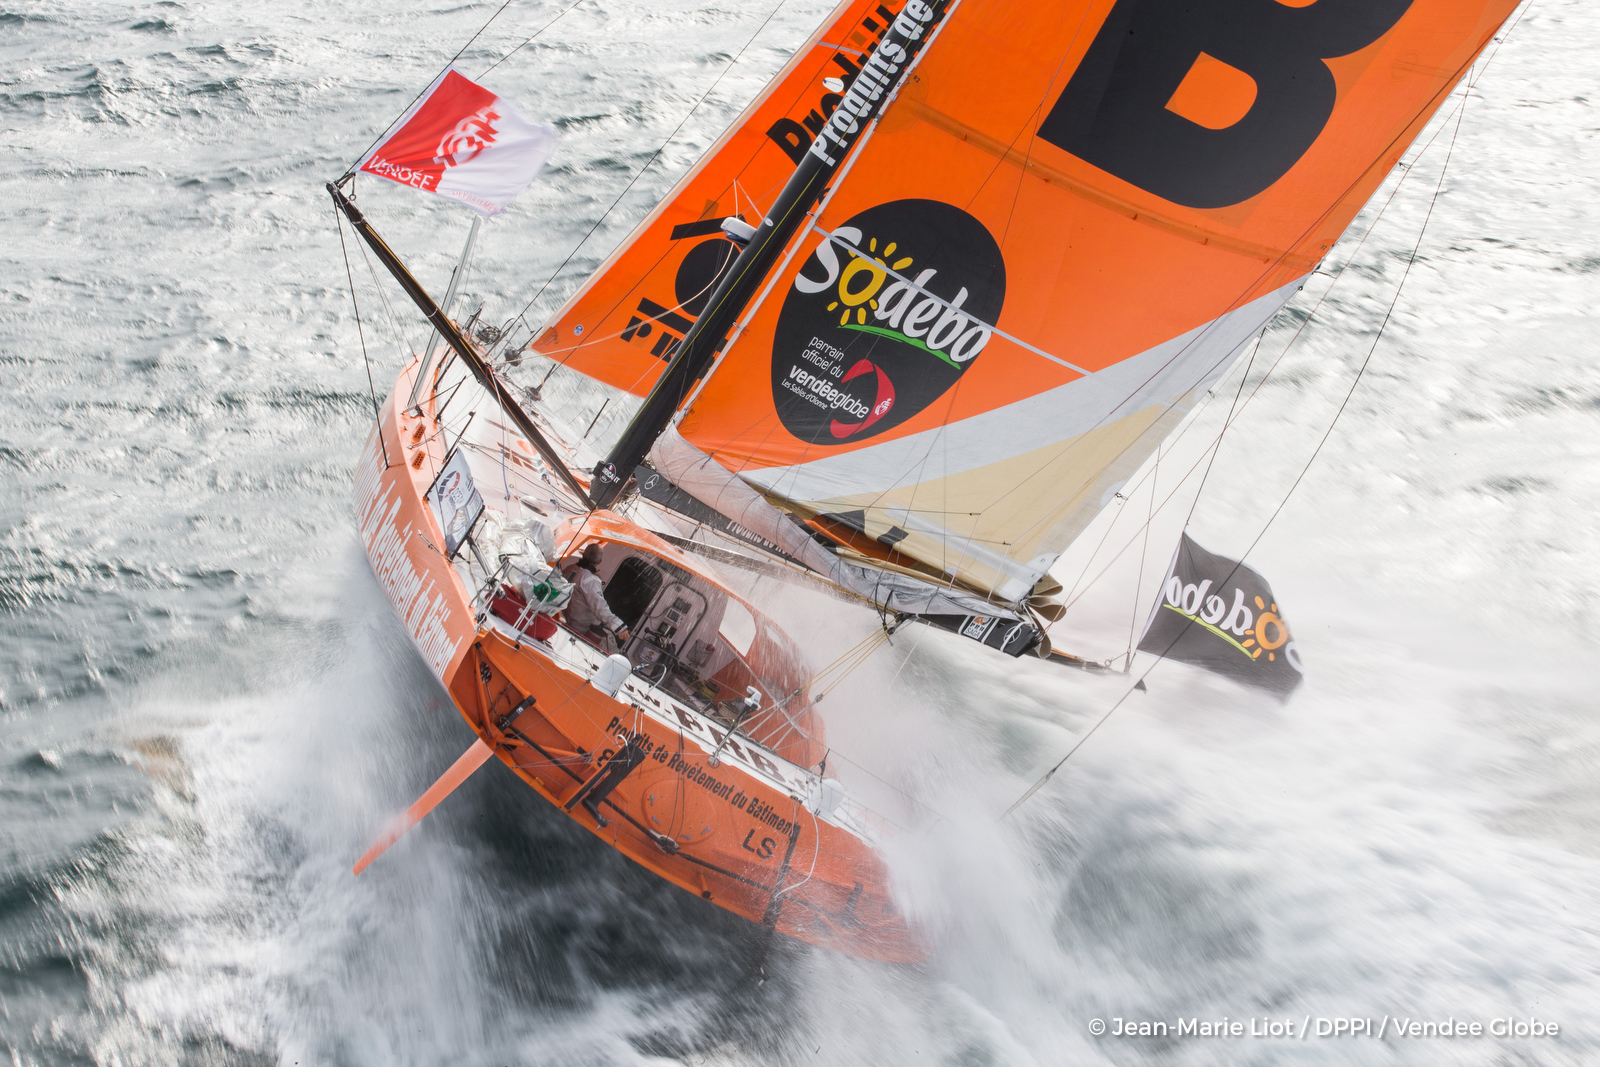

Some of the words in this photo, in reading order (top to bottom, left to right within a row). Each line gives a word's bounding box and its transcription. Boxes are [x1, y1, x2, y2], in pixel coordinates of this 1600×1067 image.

[810, 39, 906, 167] Produits
[795, 227, 993, 363] Sodebo
[802, 349, 834, 372] officiel
[830, 365, 844, 378] du
[808, 336, 845, 362] parrain
[781, 378, 791, 389] Les
[789, 382, 807, 398] Sables
[789, 364, 870, 418] vendéeglobe
[652, 744, 669, 764] de
[666, 751, 736, 801] Revêtement
[730, 790, 748, 810] du
[741, 828, 777, 860] LS
